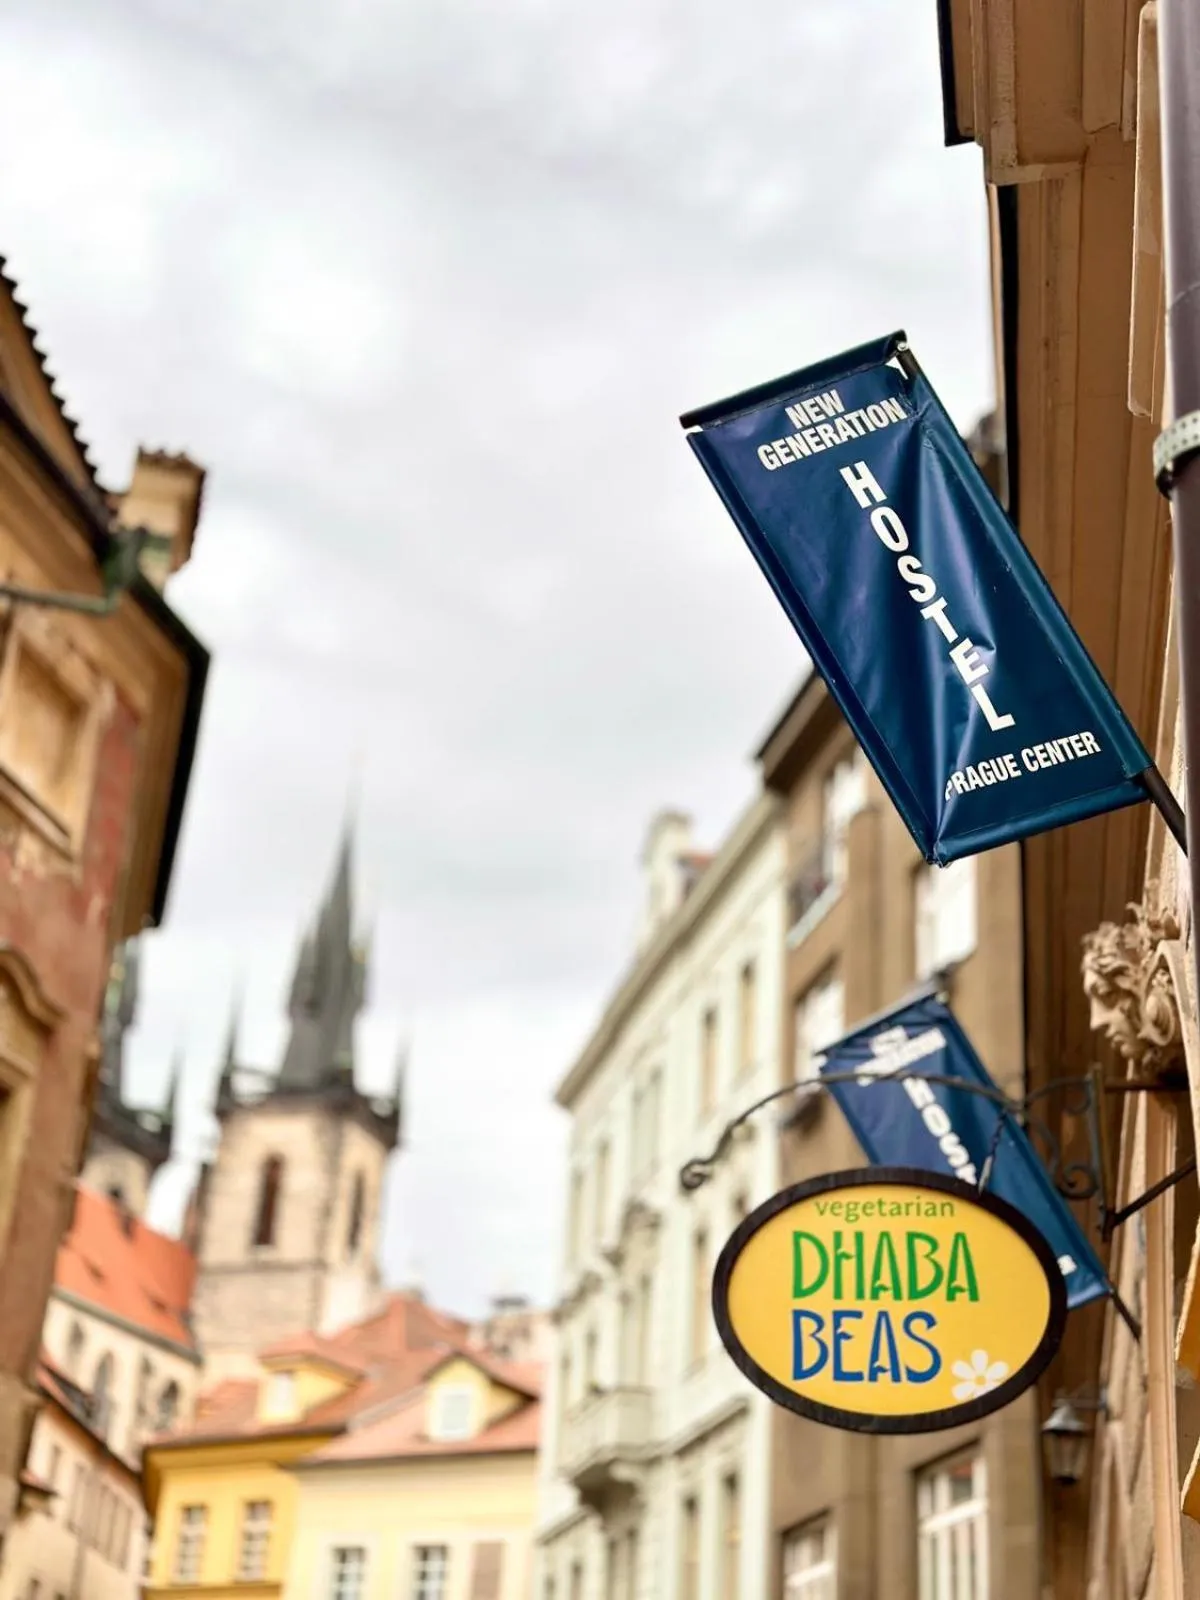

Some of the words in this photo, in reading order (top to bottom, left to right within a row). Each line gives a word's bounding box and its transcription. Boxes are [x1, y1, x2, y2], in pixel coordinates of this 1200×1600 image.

[757, 397, 907, 471] GENERATION
[785, 389, 845, 429] NEW
[839, 460, 1016, 731] HOSTEL
[1020, 731, 1101, 772] CENTER
[902, 1077, 977, 1185] HOST
[814, 1195, 955, 1223] vegetarian
[792, 1230, 980, 1302] DHABA
[792, 1309, 942, 1383] BEAS
